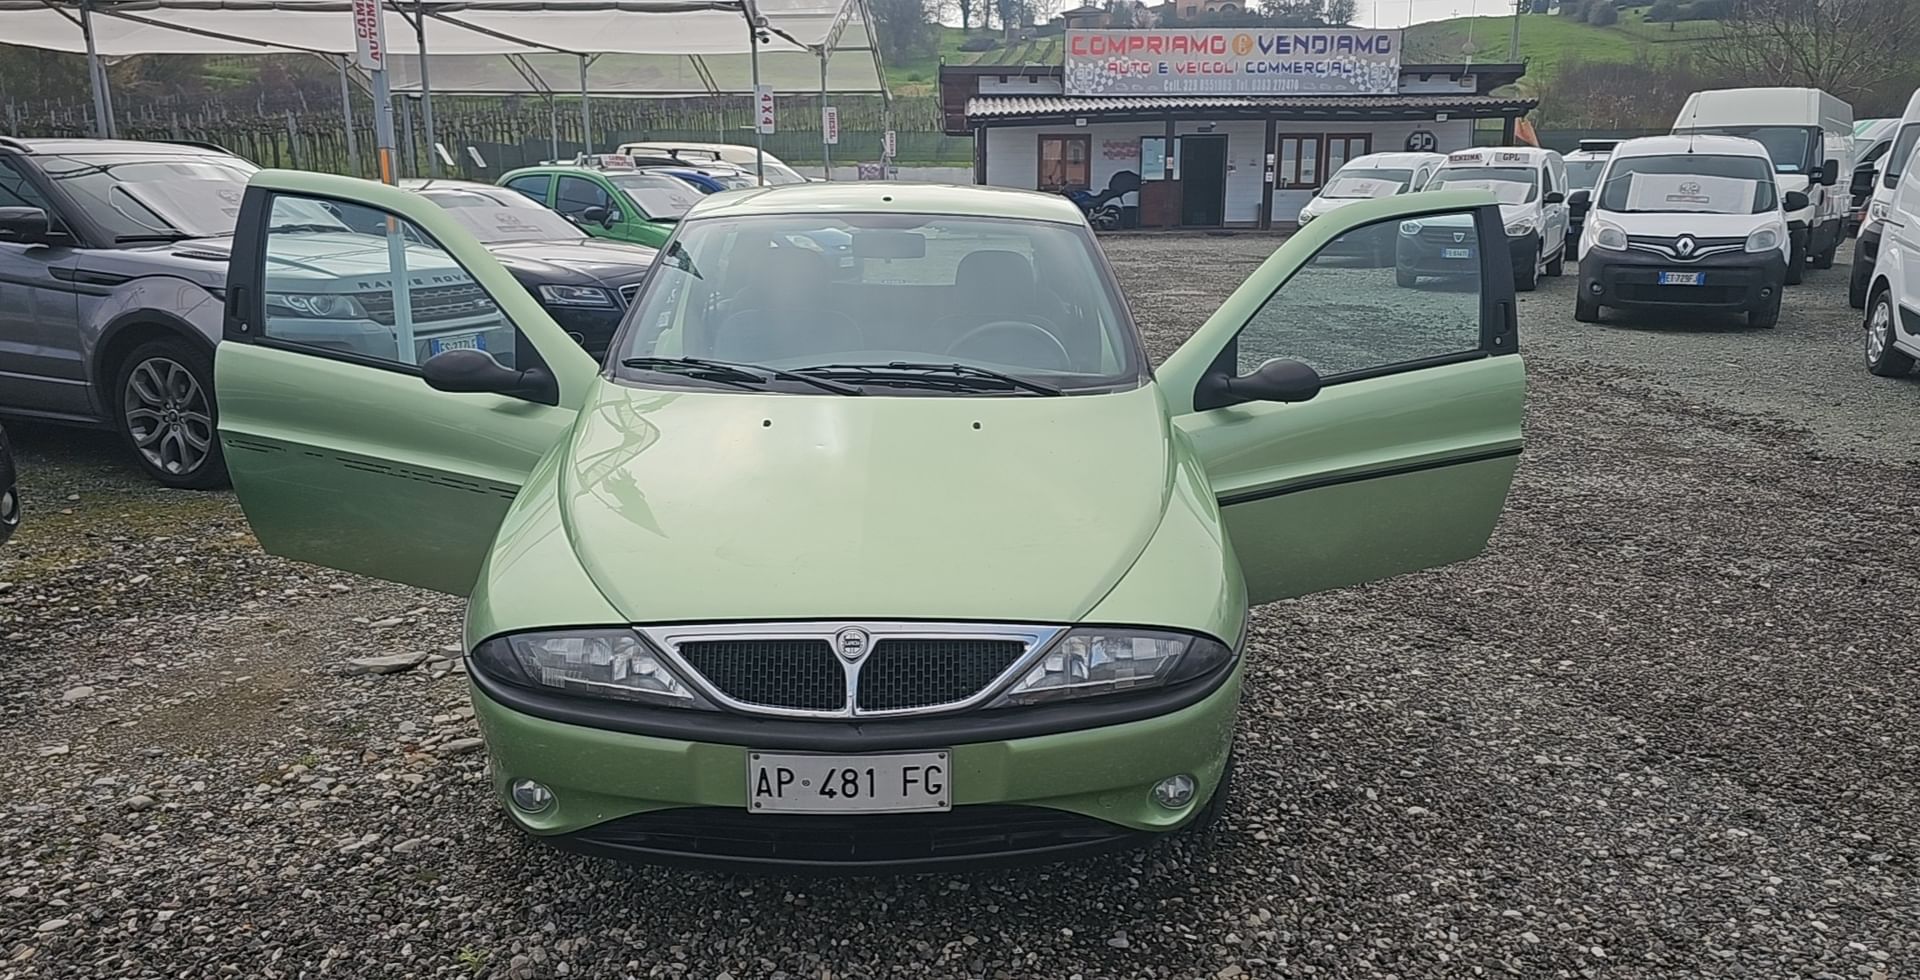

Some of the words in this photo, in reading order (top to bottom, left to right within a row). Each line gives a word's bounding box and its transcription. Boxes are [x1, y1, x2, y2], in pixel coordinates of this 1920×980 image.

[356, 0, 367, 38] CAM
[366, 0, 379, 61] AUTOM
[1071, 35, 1226, 55] COMPRIAMO
[1258, 35, 1391, 54] VENDIAMO
[1107, 62, 1151, 74] AUTO
[1158, 62, 1168, 74] E
[1176, 62, 1238, 74] VEICOLI
[1245, 61, 1357, 73] COMMERCIALI
[829, 112, 837, 139] DIESEL
[1502, 153, 1520, 161] GPL
[358, 278, 423, 289] RANE
[756, 767, 794, 798] AP
[819, 768, 874, 799] 481
[902, 765, 943, 797] FG
